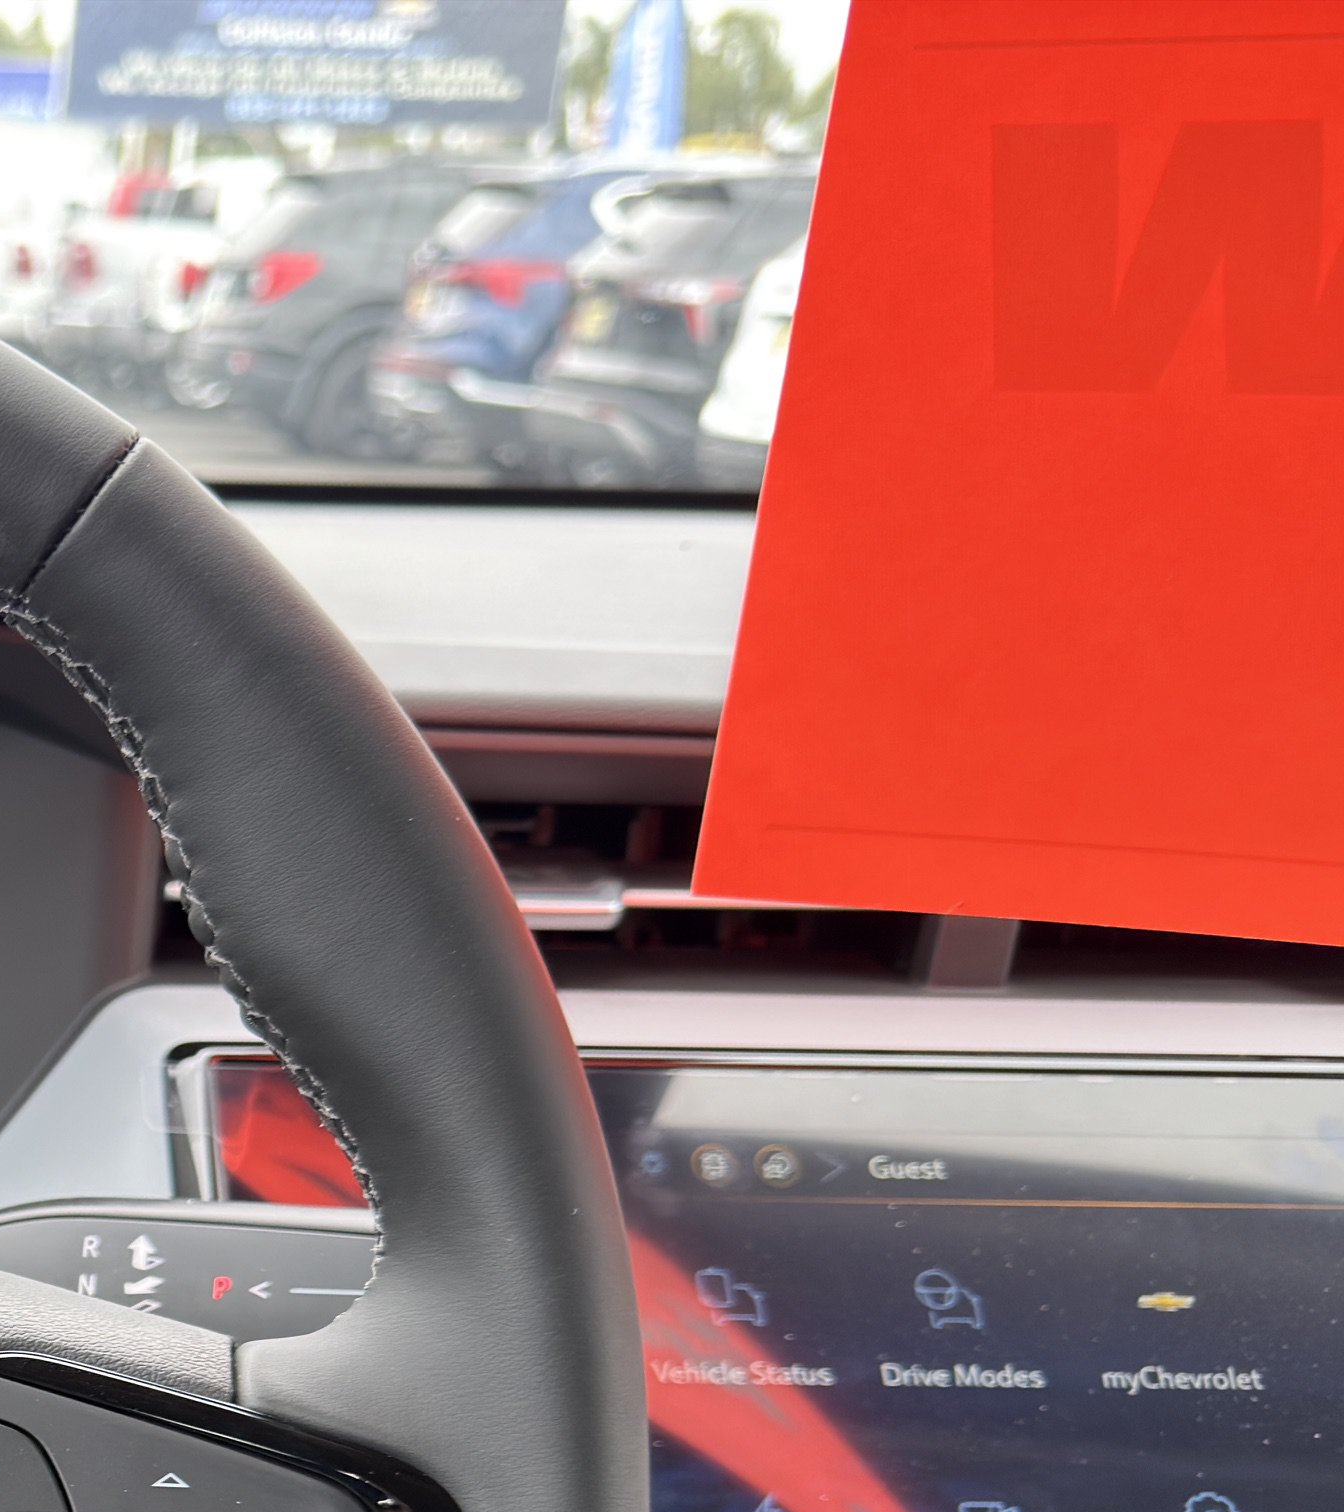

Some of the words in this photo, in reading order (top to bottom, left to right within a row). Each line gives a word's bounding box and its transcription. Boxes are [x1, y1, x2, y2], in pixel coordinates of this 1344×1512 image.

[868, 1154, 949, 1180] Guest
[82, 1234, 101, 1258] R
[77, 1273, 98, 1296] N
[213, 1276, 233, 1300] P
[651, 1360, 746, 1386] Vehicle
[749, 1361, 835, 1387] Status
[881, 1363, 949, 1389] Drive
[954, 1363, 1047, 1390] Modes
[1102, 1366, 1264, 1396] myChevrolet
